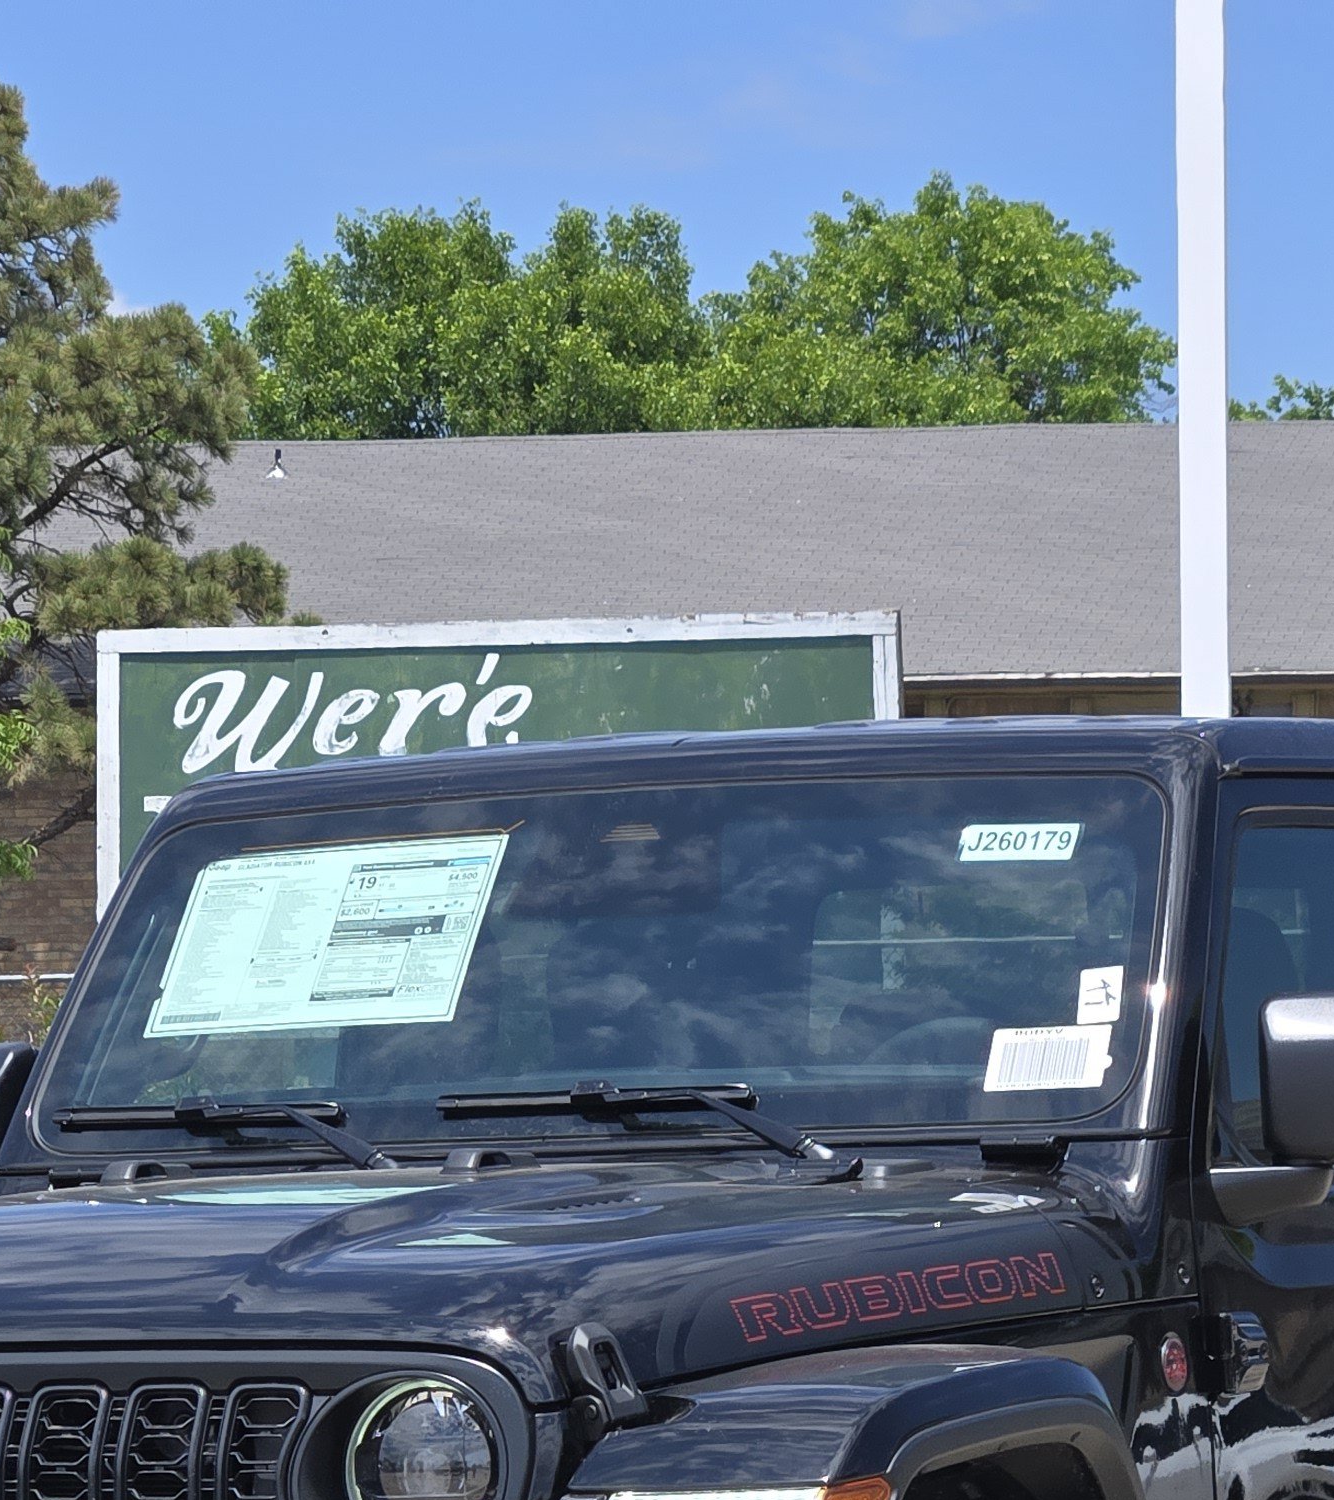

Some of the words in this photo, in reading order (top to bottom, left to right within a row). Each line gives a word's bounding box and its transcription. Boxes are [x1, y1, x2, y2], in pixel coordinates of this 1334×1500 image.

[968, 830, 1073, 852] J260179
[357, 876, 378, 890] 19
[729, 1251, 1068, 1344] RUBICON
